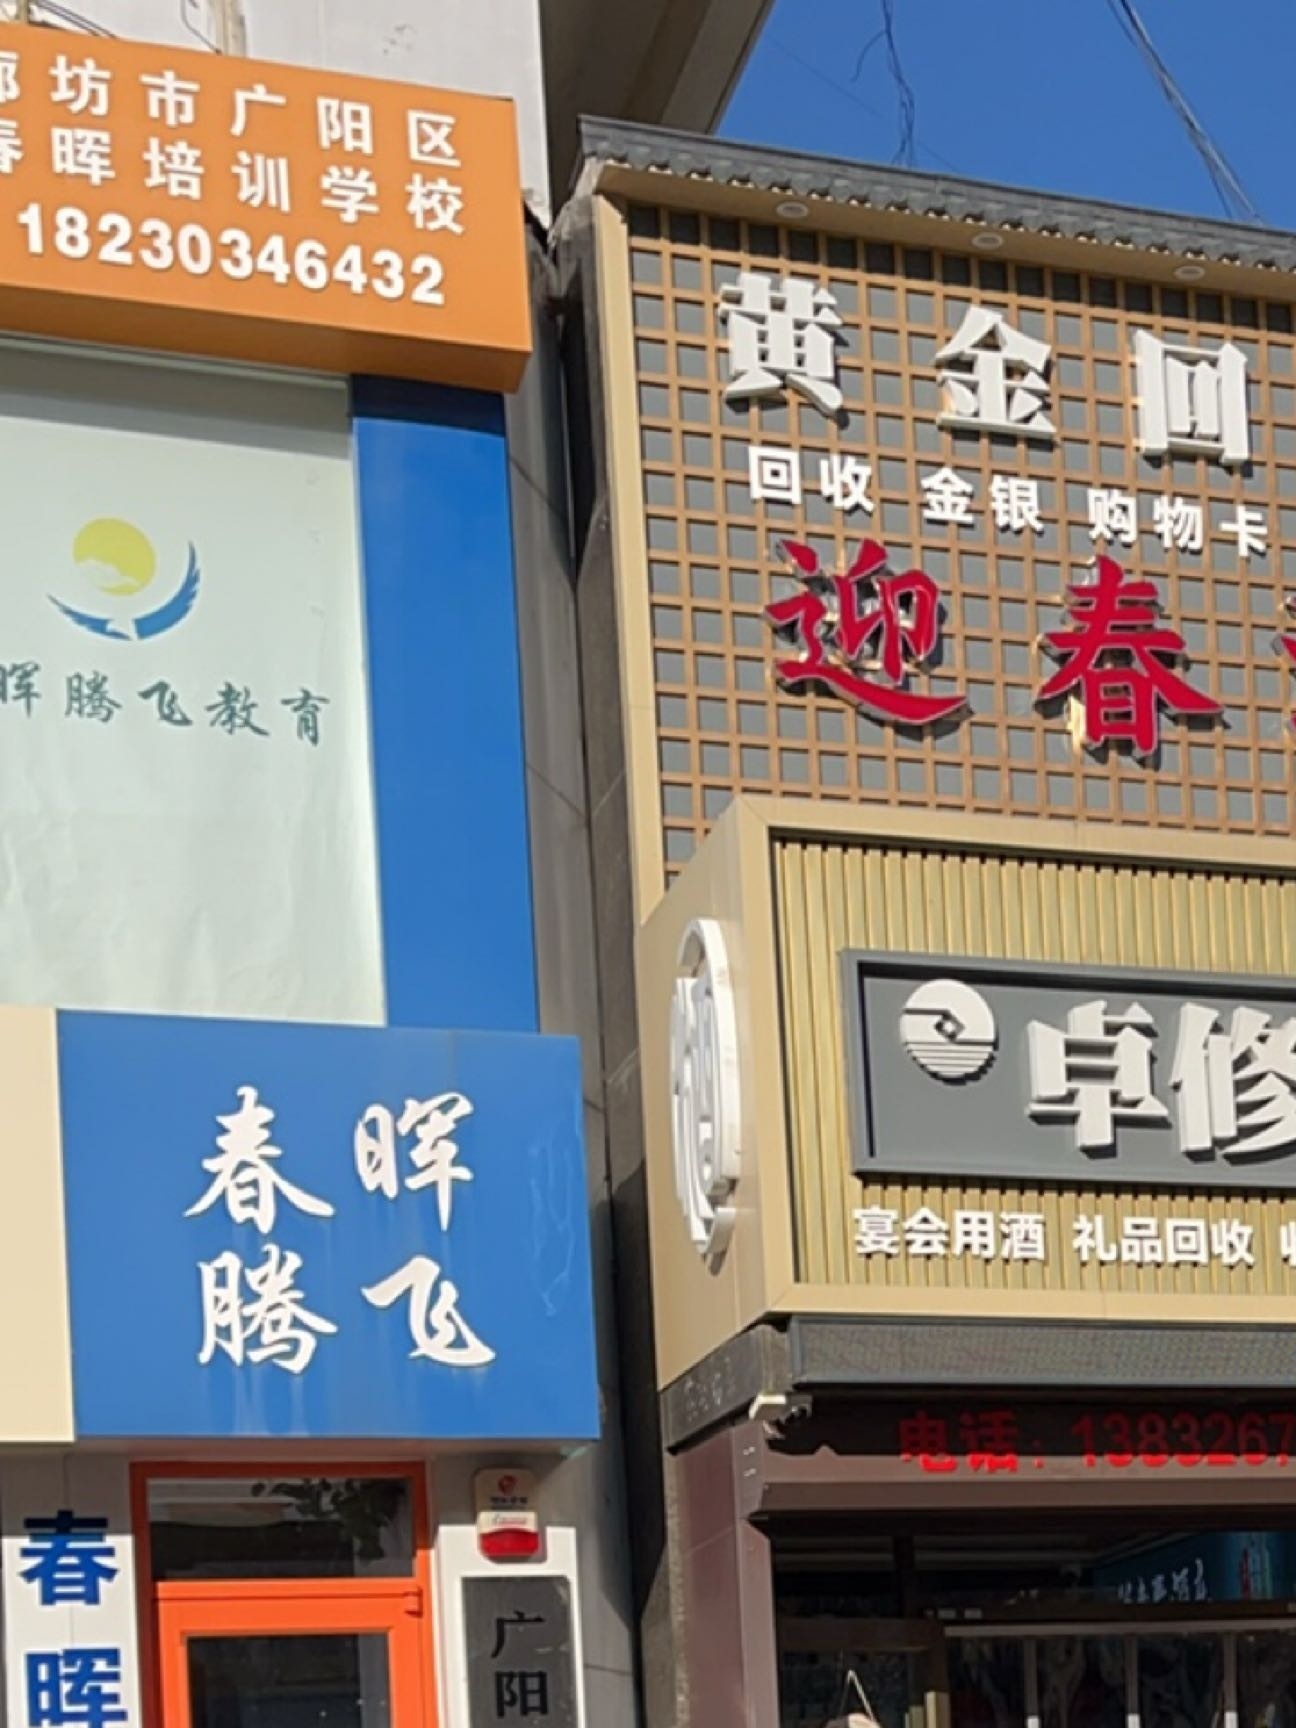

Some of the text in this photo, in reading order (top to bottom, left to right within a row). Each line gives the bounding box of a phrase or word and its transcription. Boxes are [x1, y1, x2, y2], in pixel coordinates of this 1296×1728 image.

[17, 200, 446, 305] 18230346432
[747, 444, 876, 516] 回收
[920, 465, 1045, 534] 金银
[1086, 486, 1270, 559] 购物卡
[0, 660, 331, 747] 晖腾飞教育
[183, 1085, 475, 1233] 春晖
[852, 1206, 1047, 1261] 宴会用酒
[1072, 1213, 1256, 1267] 礼品回收
[196, 1242, 497, 1374] 腾飞
